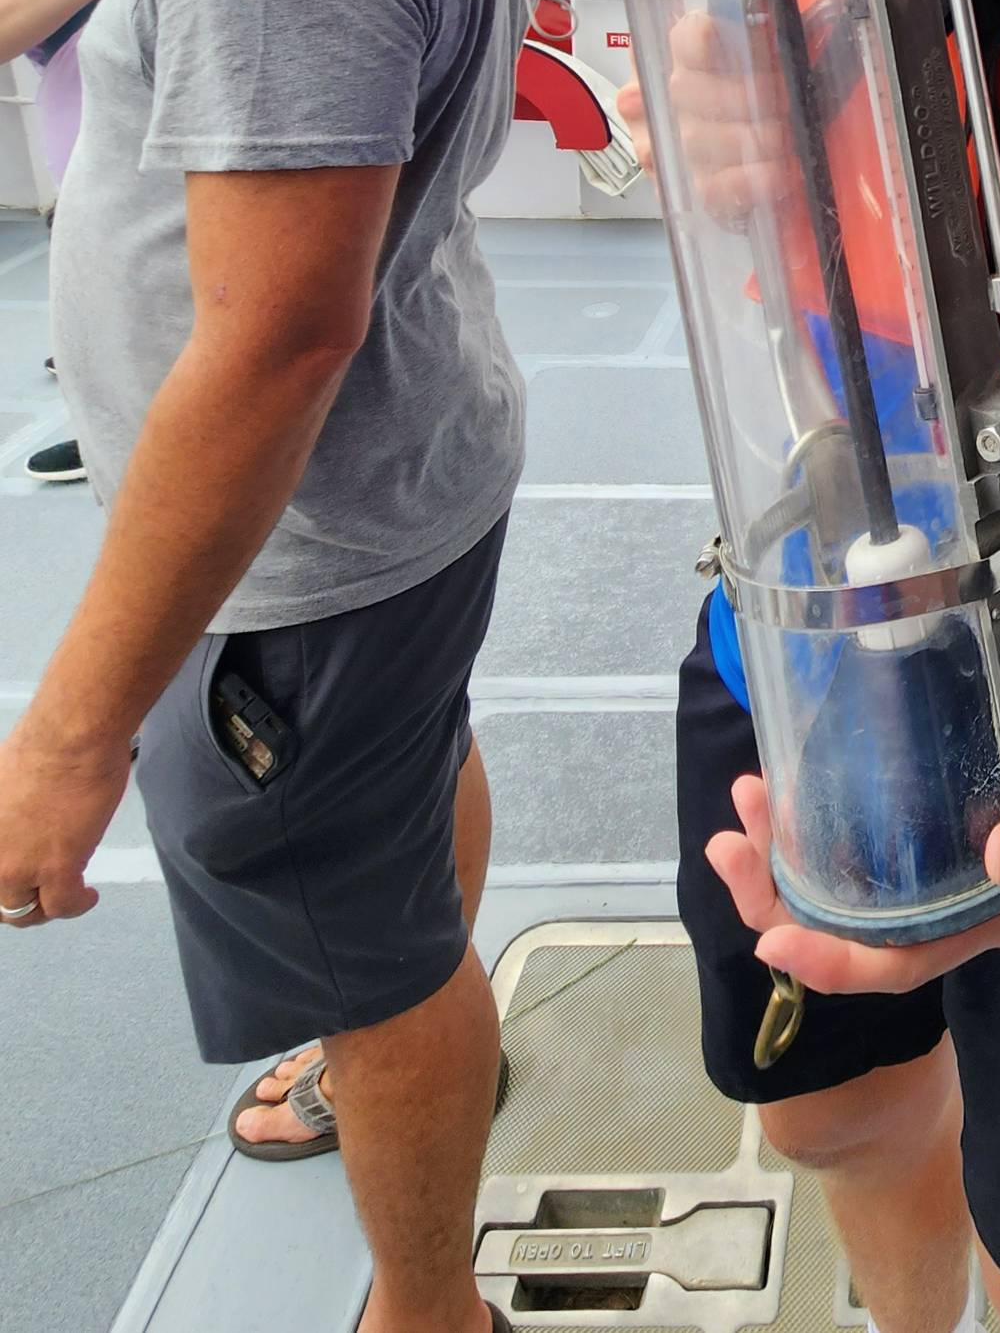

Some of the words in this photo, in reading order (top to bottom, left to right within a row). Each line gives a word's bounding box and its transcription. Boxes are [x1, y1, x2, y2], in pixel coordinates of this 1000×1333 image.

[516, 1242, 563, 1262] OPEN
[571, 1242, 593, 1260] TO
[602, 1241, 647, 1260] LIFT
